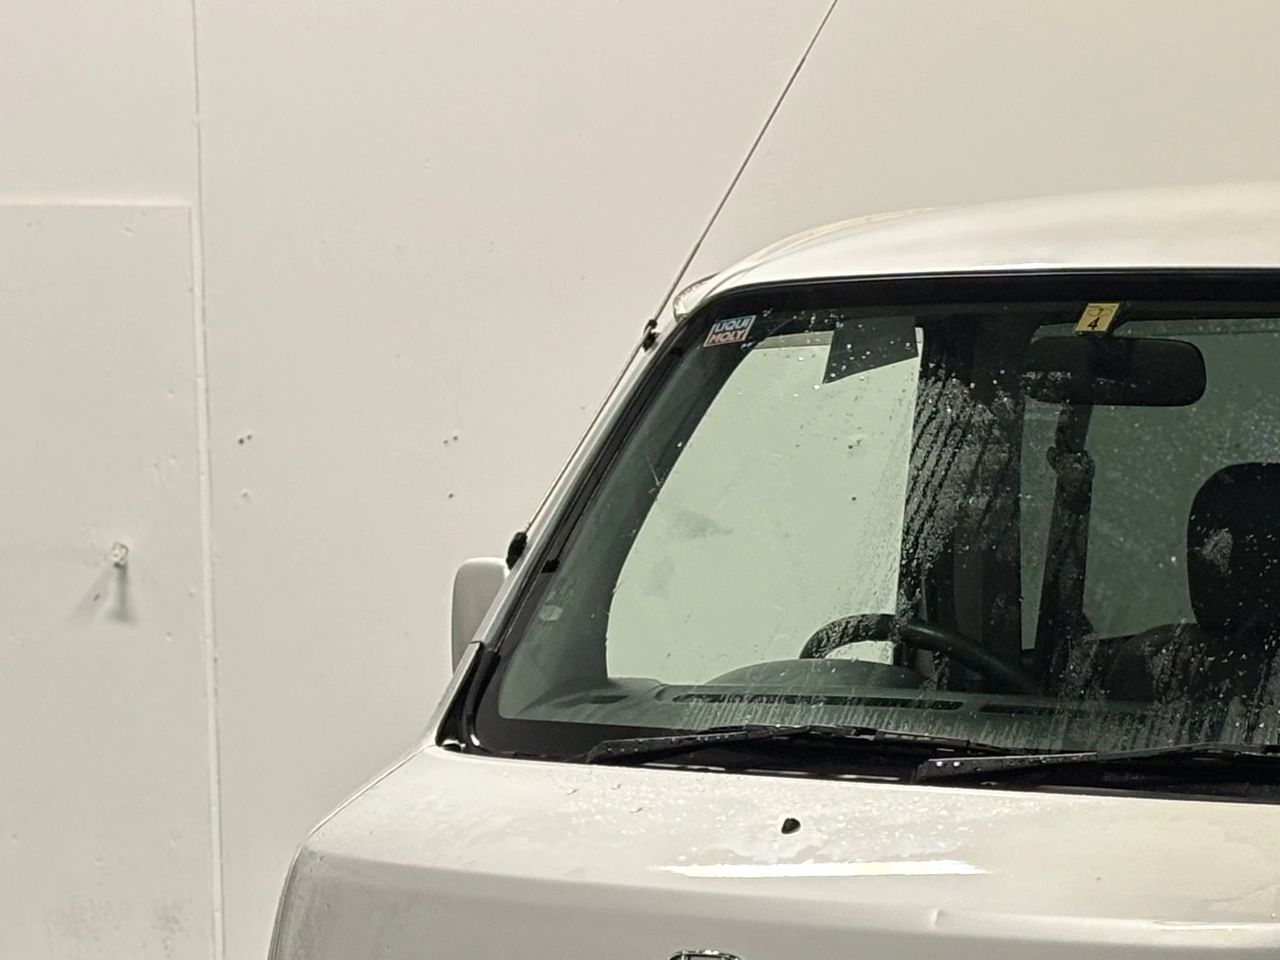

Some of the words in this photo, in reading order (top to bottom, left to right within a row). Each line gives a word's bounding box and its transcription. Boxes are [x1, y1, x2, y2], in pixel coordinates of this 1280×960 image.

[714, 318, 751, 333] LIQUI
[1086, 317, 1100, 330] 4
[709, 329, 746, 344] MOLY
